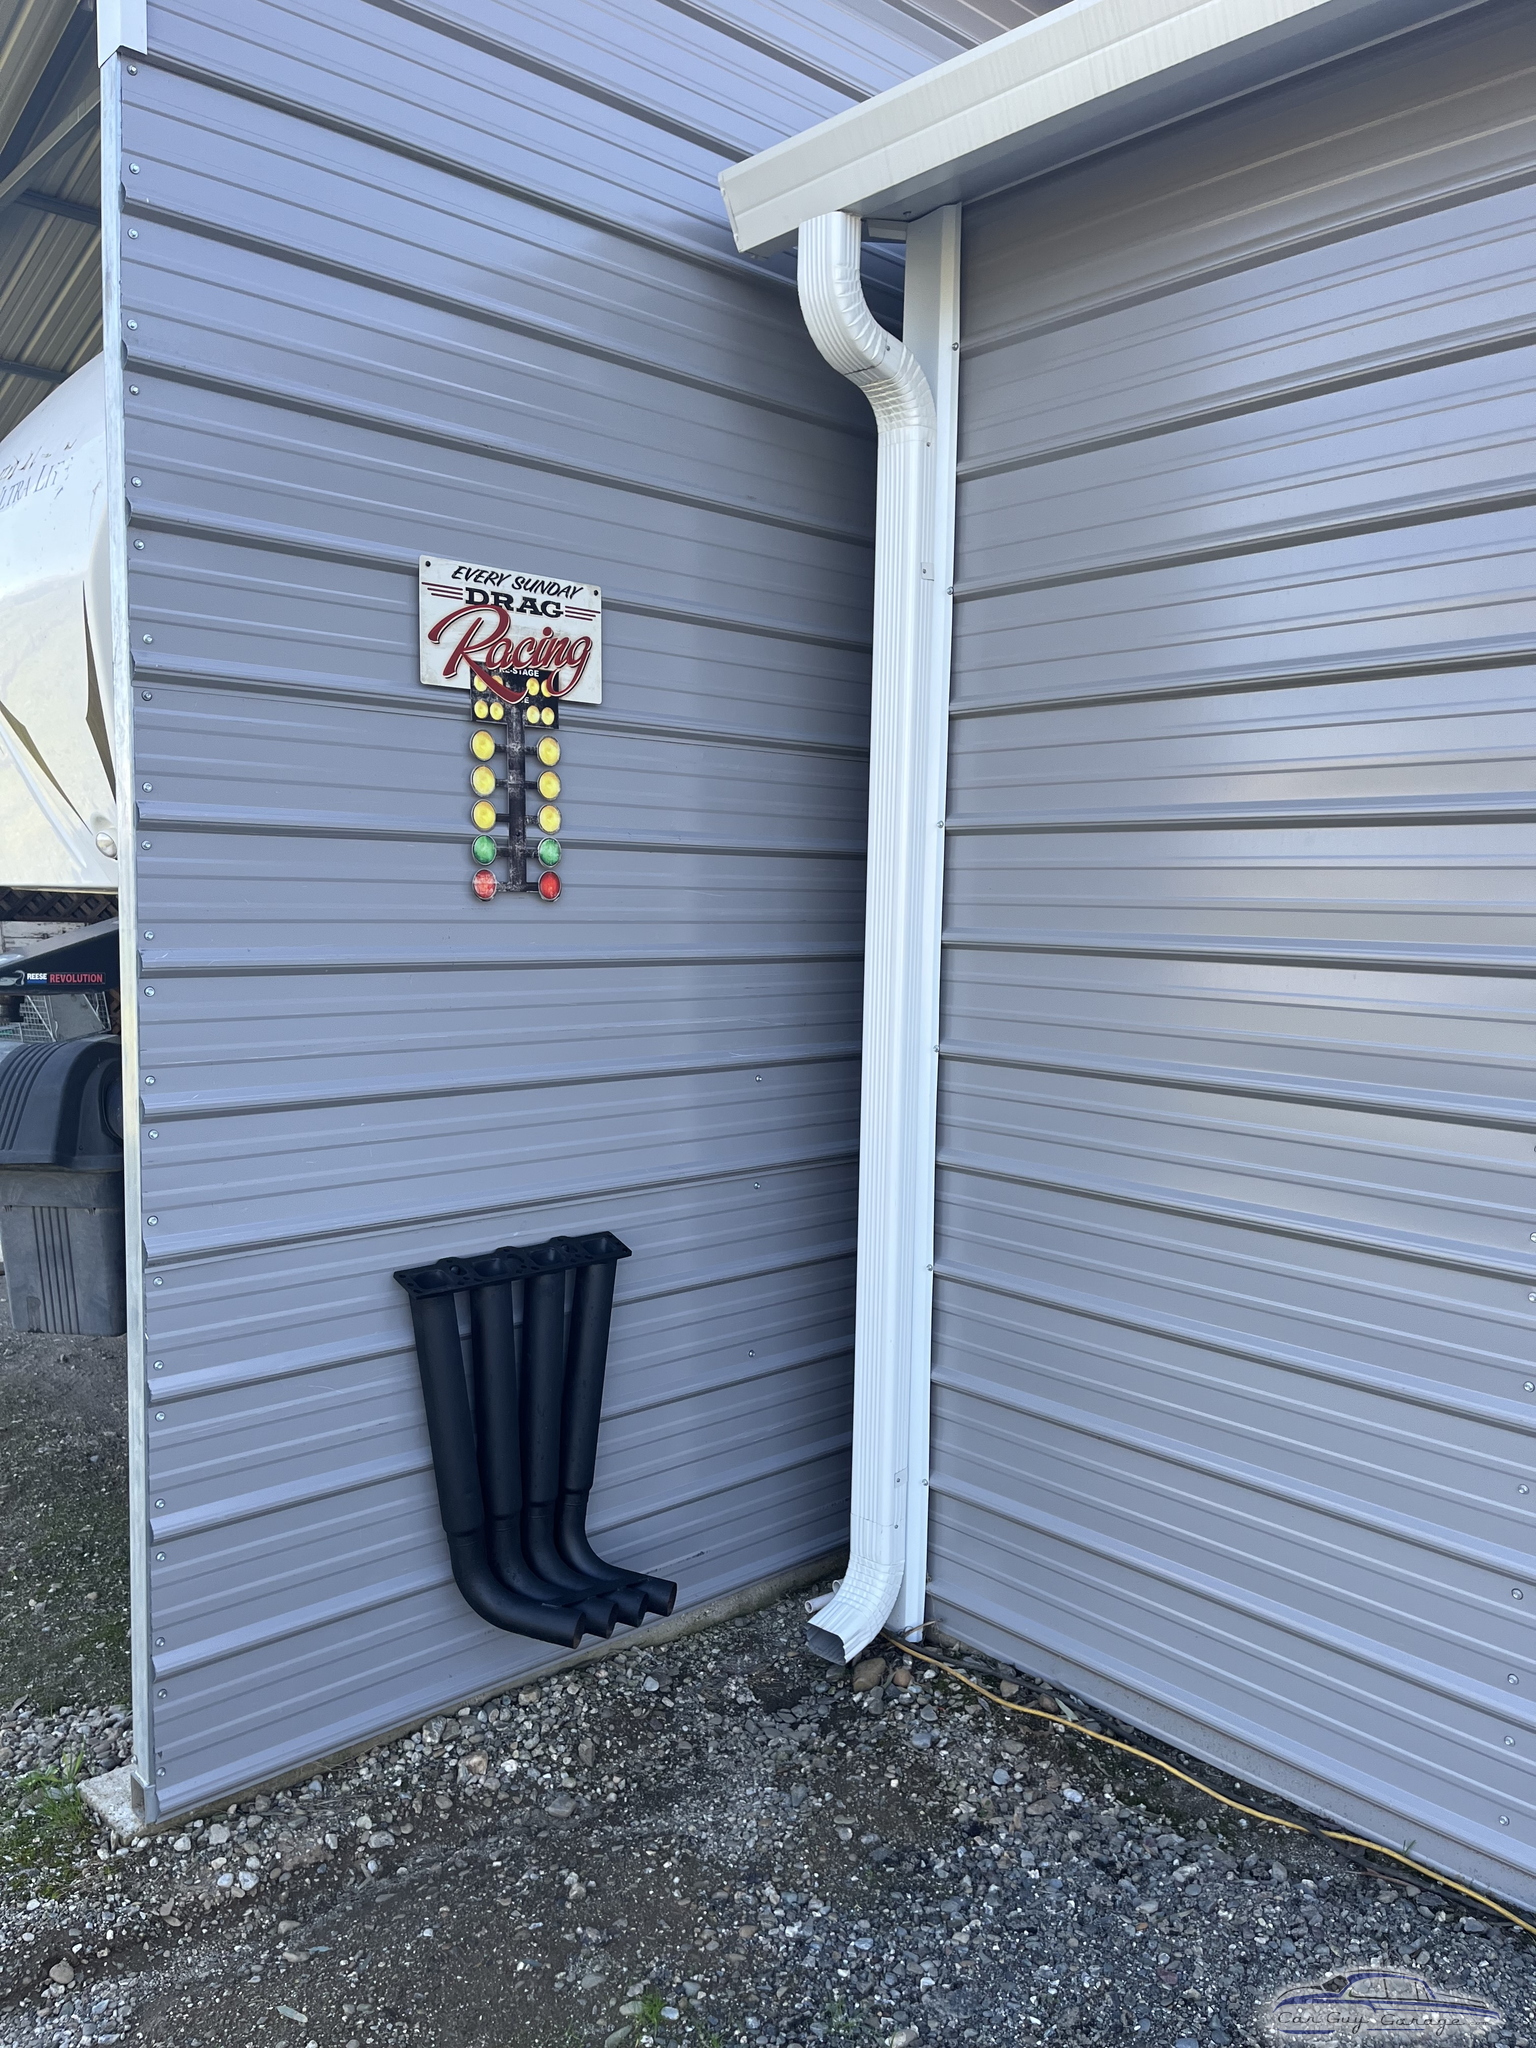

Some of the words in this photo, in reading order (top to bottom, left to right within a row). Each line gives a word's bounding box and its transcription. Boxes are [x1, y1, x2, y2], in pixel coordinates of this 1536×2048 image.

[451, 566, 511, 587] EVERY
[511, 576, 583, 599] SUNDAY
[465, 587, 563, 618] DRAG
[427, 604, 593, 704] Racing
[49, 974, 103, 983] REVOLUTION
